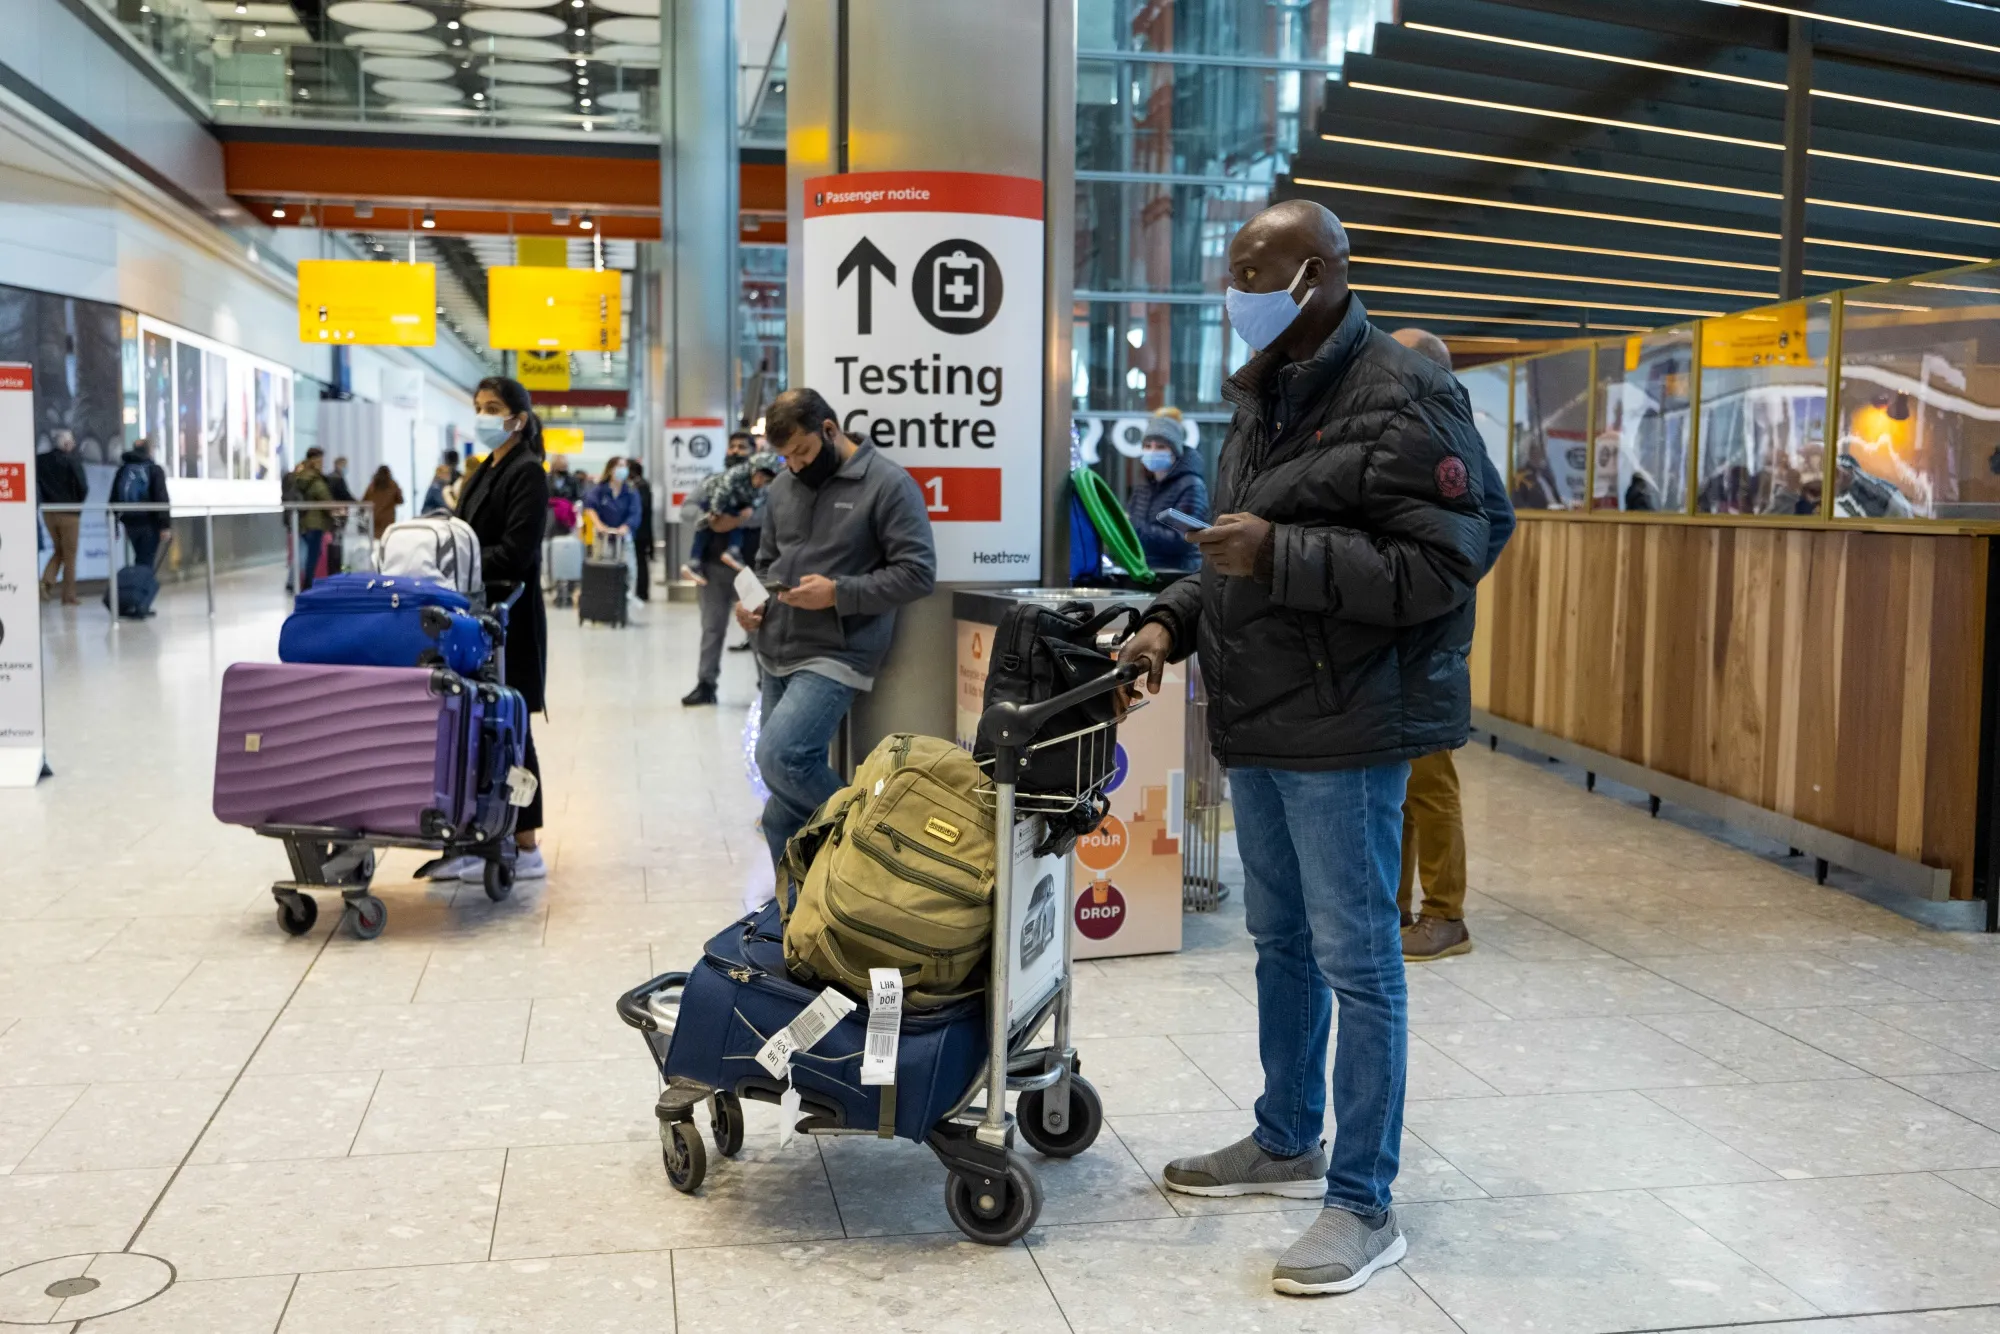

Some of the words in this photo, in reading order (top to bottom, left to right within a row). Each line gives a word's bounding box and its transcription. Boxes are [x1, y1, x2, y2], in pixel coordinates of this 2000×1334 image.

[826, 189, 884, 204] Passenger
[887, 187, 930, 201] notice
[834, 353, 1003, 407] Testing
[925, 475, 949, 513] 1
[973, 551, 1031, 565] Heathrow
[1081, 834, 1121, 848] POUR
[1080, 905, 1121, 920] DROP
[880, 980, 896, 990] LHR
[879, 996, 896, 1005] DOH
[767, 1050, 779, 1067] LHR
